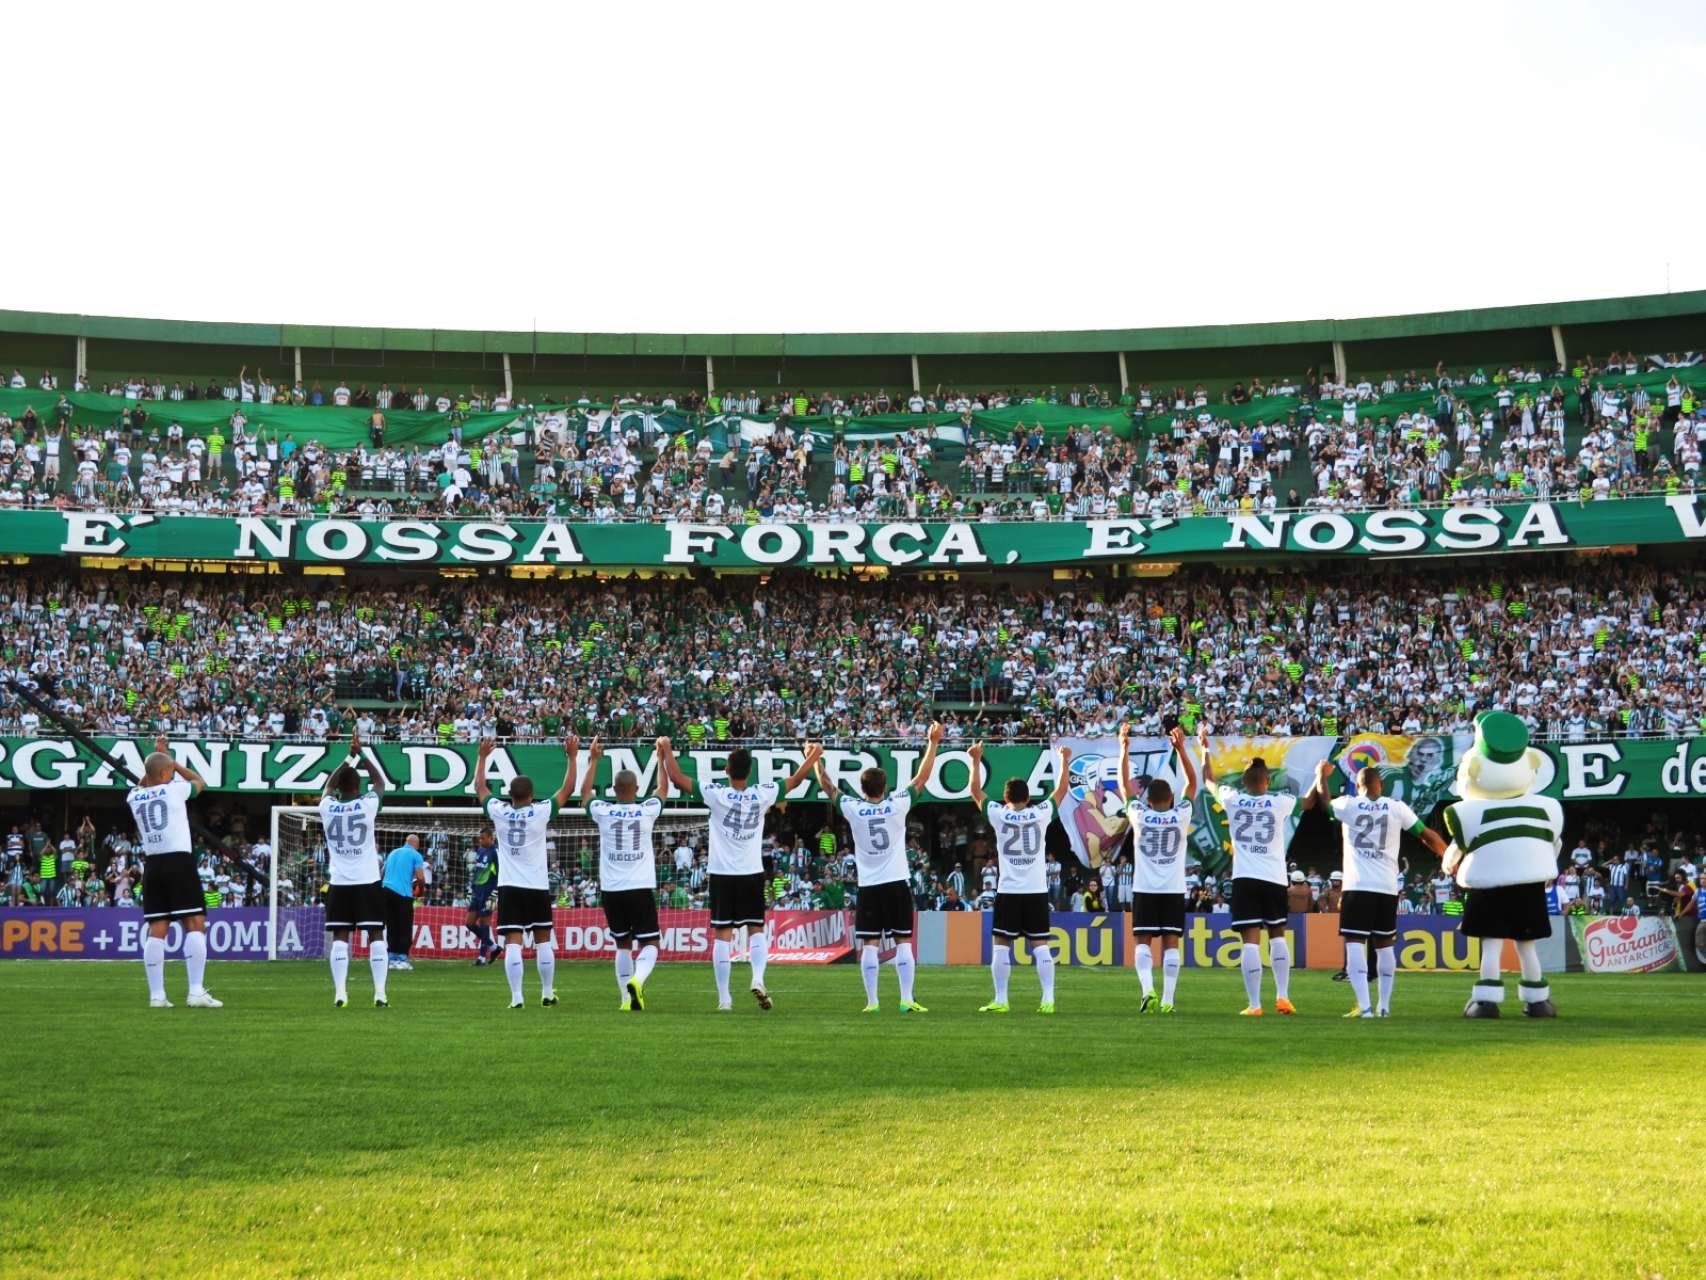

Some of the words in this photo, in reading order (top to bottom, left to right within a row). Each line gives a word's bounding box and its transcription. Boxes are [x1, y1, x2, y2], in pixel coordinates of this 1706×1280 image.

[234, 517, 584, 562] NOSSA
[1223, 502, 1569, 551] NOSSA
[0, 740, 521, 795] GANIZADA
[135, 788, 167, 801] CAIXA
[328, 802, 362, 813] CAIXA
[725, 792, 758, 801] CAIXA
[1238, 798, 1272, 808] CAIXA
[1358, 801, 1389, 811] CAIXA
[135, 799, 169, 833] 10
[609, 810, 642, 818] CAIXA
[722, 802, 760, 833] 44
[858, 805, 892, 817] CAIXA
[1005, 812, 1036, 821] CAIXA
[1144, 815, 1178, 825] CAIXA
[1234, 809, 1276, 845] 23
[326, 813, 368, 848] 45
[610, 818, 641, 851] 11
[868, 817, 890, 850] 5
[1001, 821, 1042, 856] 20
[1139, 825, 1181, 858] 30
[1354, 813, 1389, 850] 21
[3, 920, 85, 952] PRE
